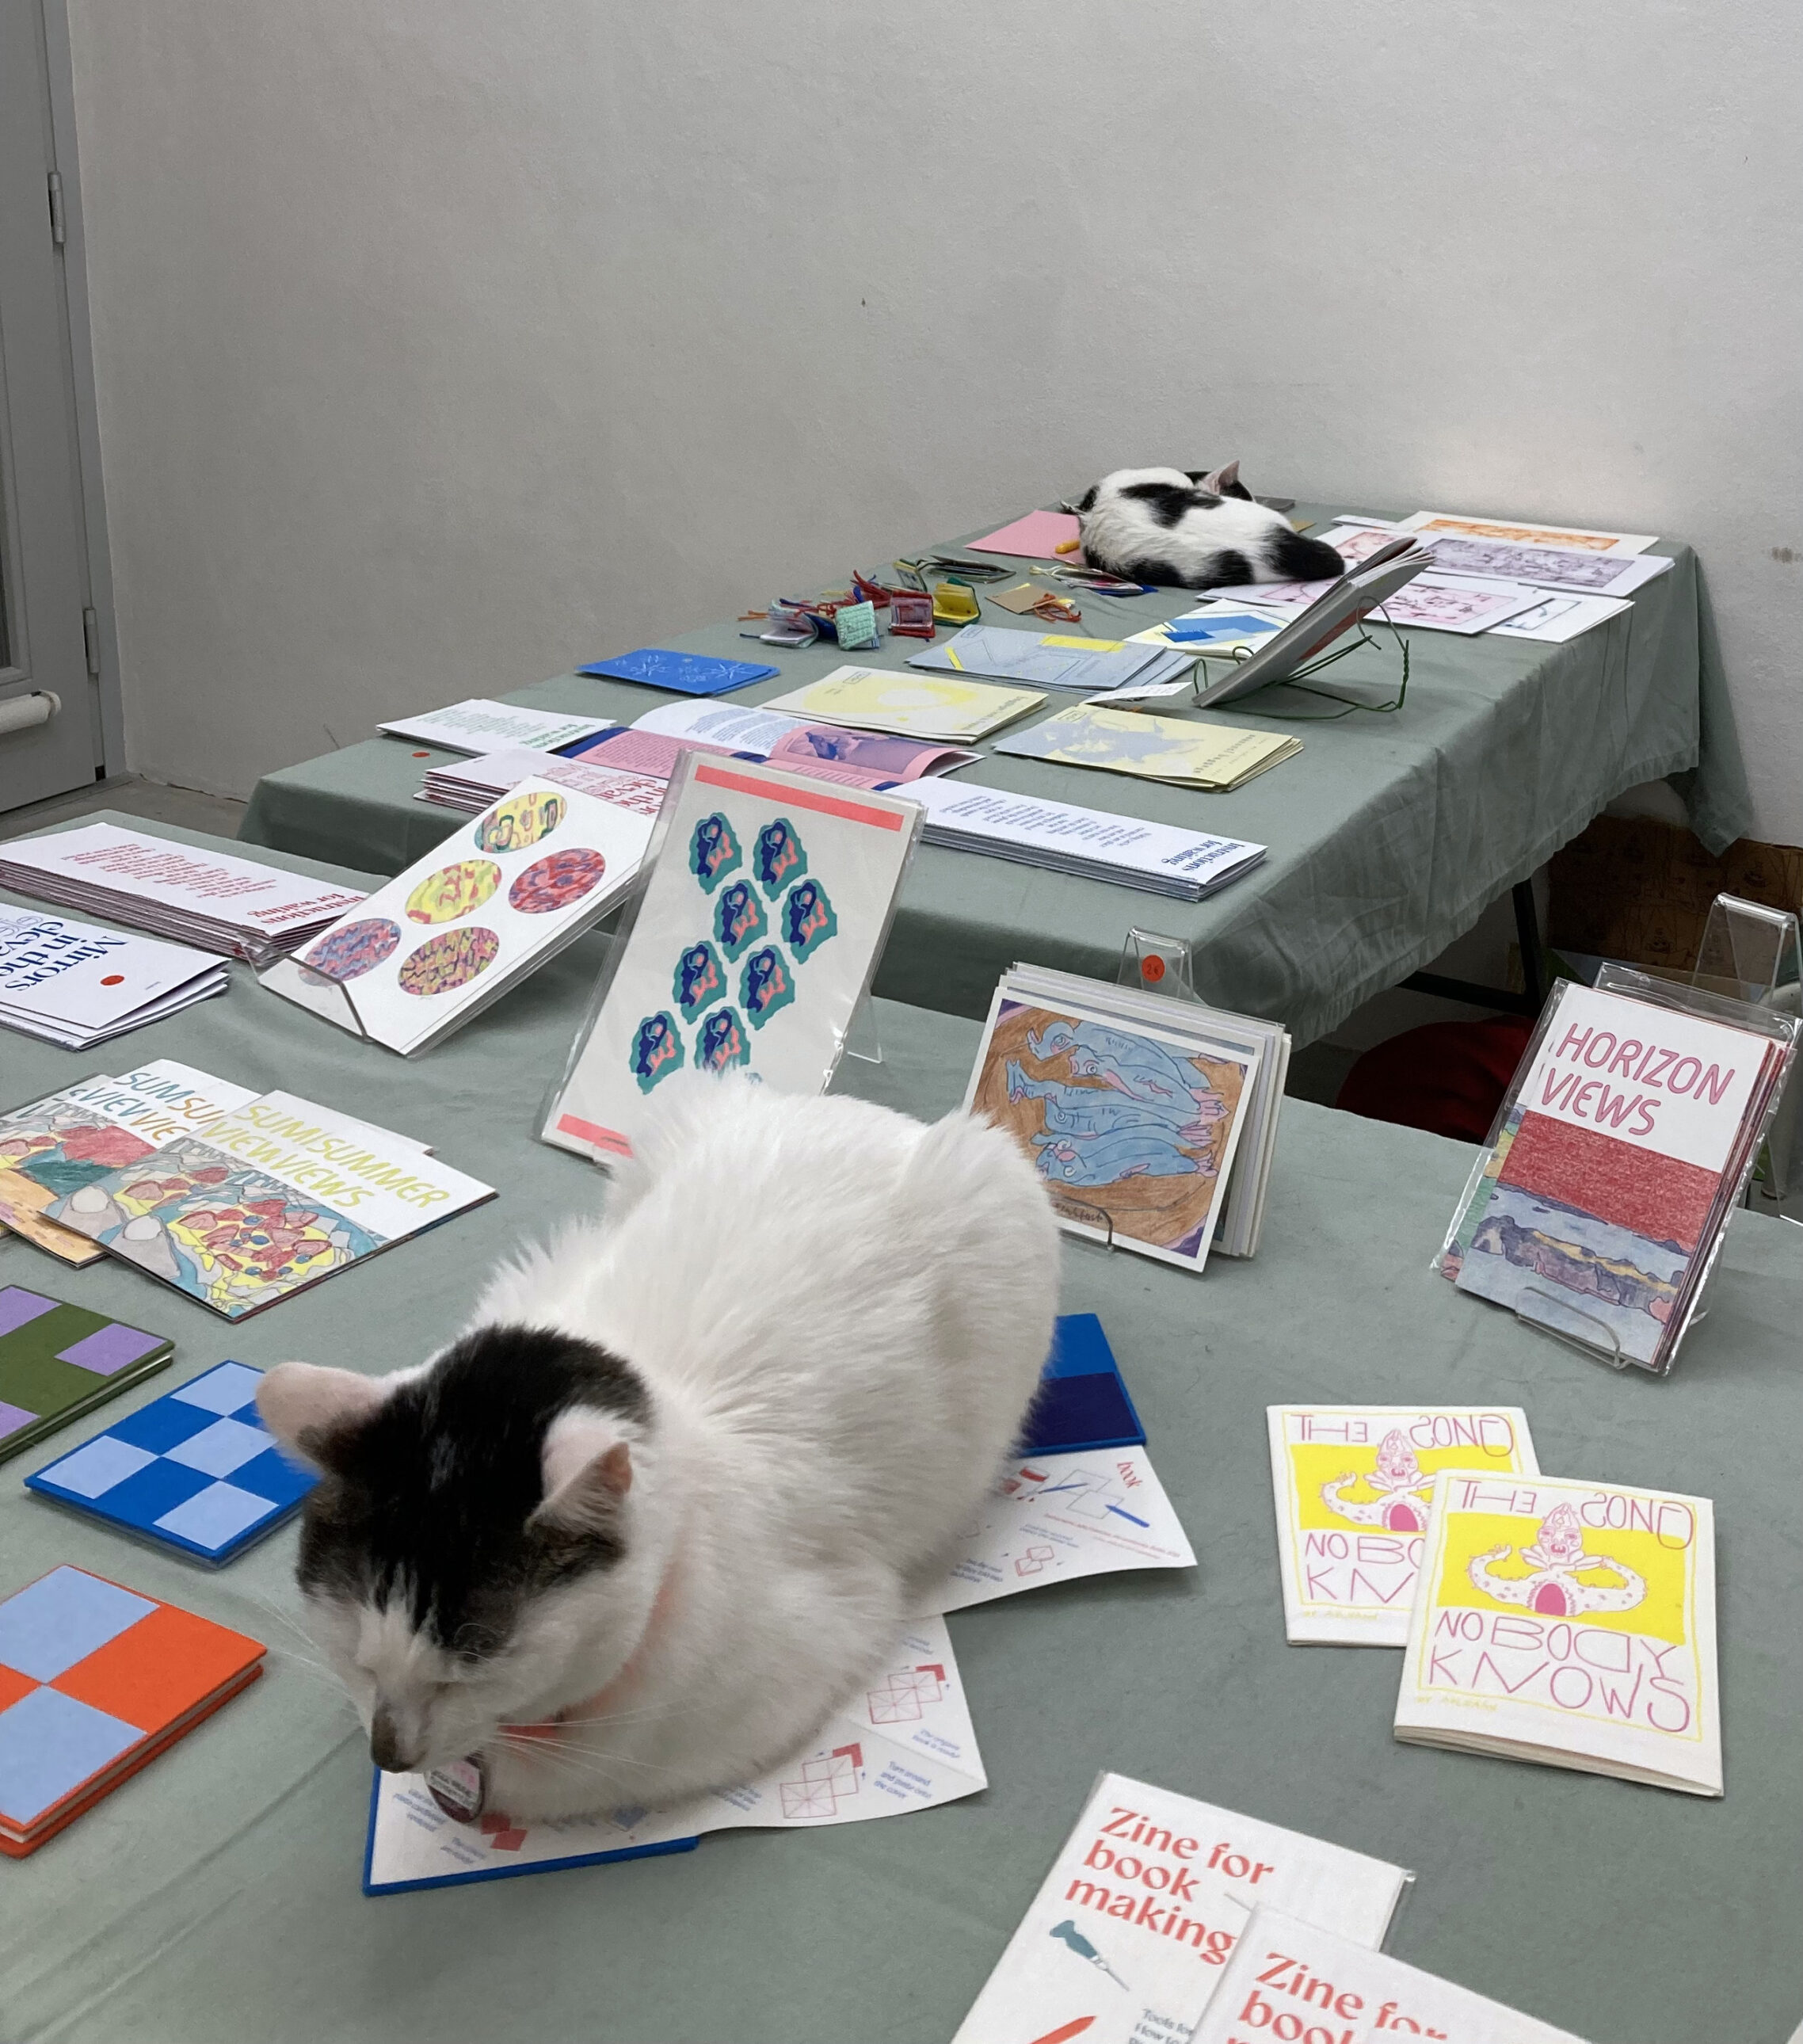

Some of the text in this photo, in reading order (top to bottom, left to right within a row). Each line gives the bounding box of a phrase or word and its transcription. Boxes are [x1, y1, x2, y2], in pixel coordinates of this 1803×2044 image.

[1161, 840, 1223, 866] for waiting
[1182, 843, 1245, 872] Instructions
[246, 892, 345, 918] for waiting
[5, 936, 128, 991] Mirrors
[41, 934, 88, 950] in
[1556, 1023, 1736, 1106] HORIZON
[1542, 1067, 1661, 1136] VIEWS
[1291, 1414, 1368, 1443] THE
[1458, 1479, 1537, 1514] THE
[1430, 1645, 1691, 1733] KNOWS
[1083, 1839, 1200, 1902] book
[1100, 1806, 1275, 1884] Zine for
[1065, 1879, 1237, 1965] making
[1256, 1952, 1364, 2019] Zine
